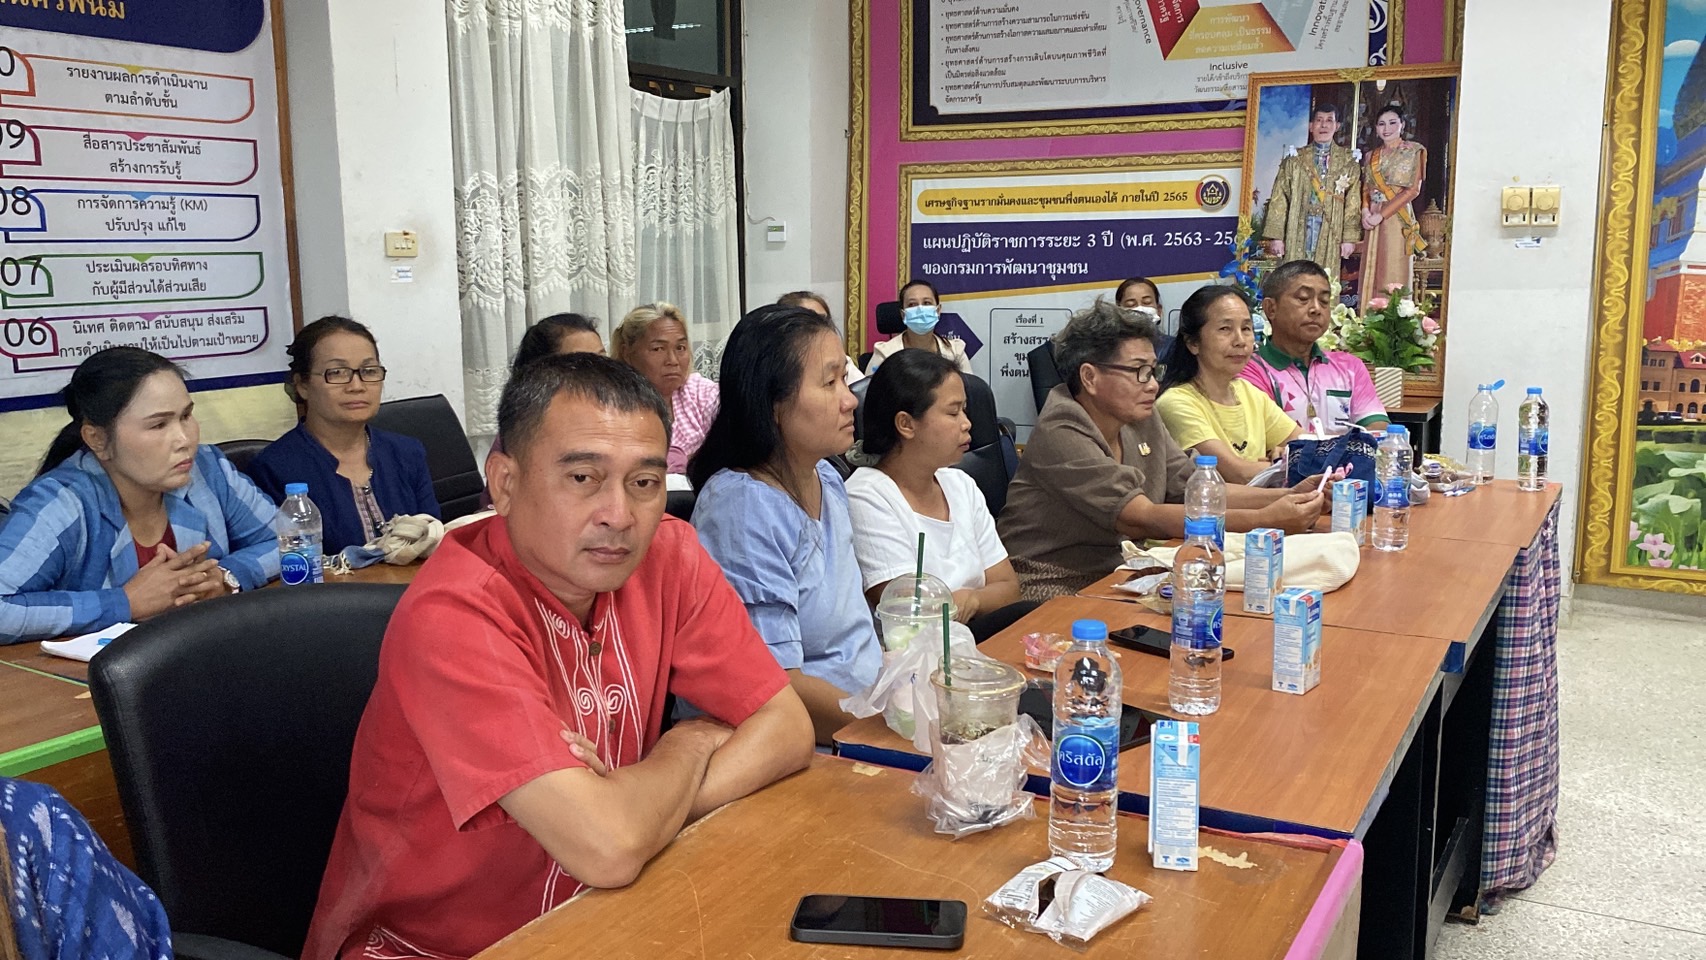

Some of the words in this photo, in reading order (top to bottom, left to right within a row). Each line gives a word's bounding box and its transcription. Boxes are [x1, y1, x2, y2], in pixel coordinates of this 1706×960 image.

[1135, 0, 1151, 44] overnance
[1308, 0, 1327, 36] Innovat
[1210, 61, 1248, 71] Inclusive
[67, 64, 208, 91] รายงานผลการดำเนินงาน
[83, 131, 202, 155] สื่อสารประชาสัมพันธ์
[110, 159, 182, 180] สร้างการรับรู้
[77, 194, 176, 214] การจัดการความรู้
[180, 198, 208, 212] (KM)
[1121, 189, 1159, 203] ภายในปี
[1163, 192, 1188, 202] 2565
[105, 217, 153, 236] ปรับปรุง
[158, 217, 186, 231] แก้ไข
[923, 233, 1080, 253] แผนปฏิบัติราชการระยะ
[1087, 233, 1096, 247] 3
[1101, 230, 1114, 247] ปี
[1120, 232, 1157, 250] (พ.ศ.
[1, 257, 43, 286] 07
[86, 258, 208, 274] ประเมินผลรอบทิศทาง
[923, 259, 1088, 281] ของกรมการพัฒนาชุมชน
[92, 280, 207, 299] กับผู้มีส่วนได้ส่วนเสีย
[73, 320, 105, 334] นิเทศ
[109, 318, 150, 332] ติดตาม
[154, 315, 204, 331] สนับสนุน
[207, 311, 245, 326] ส่งเสริม
[1016, 313, 1037, 324] เรื่องที่
[4, 316, 47, 347] 06
